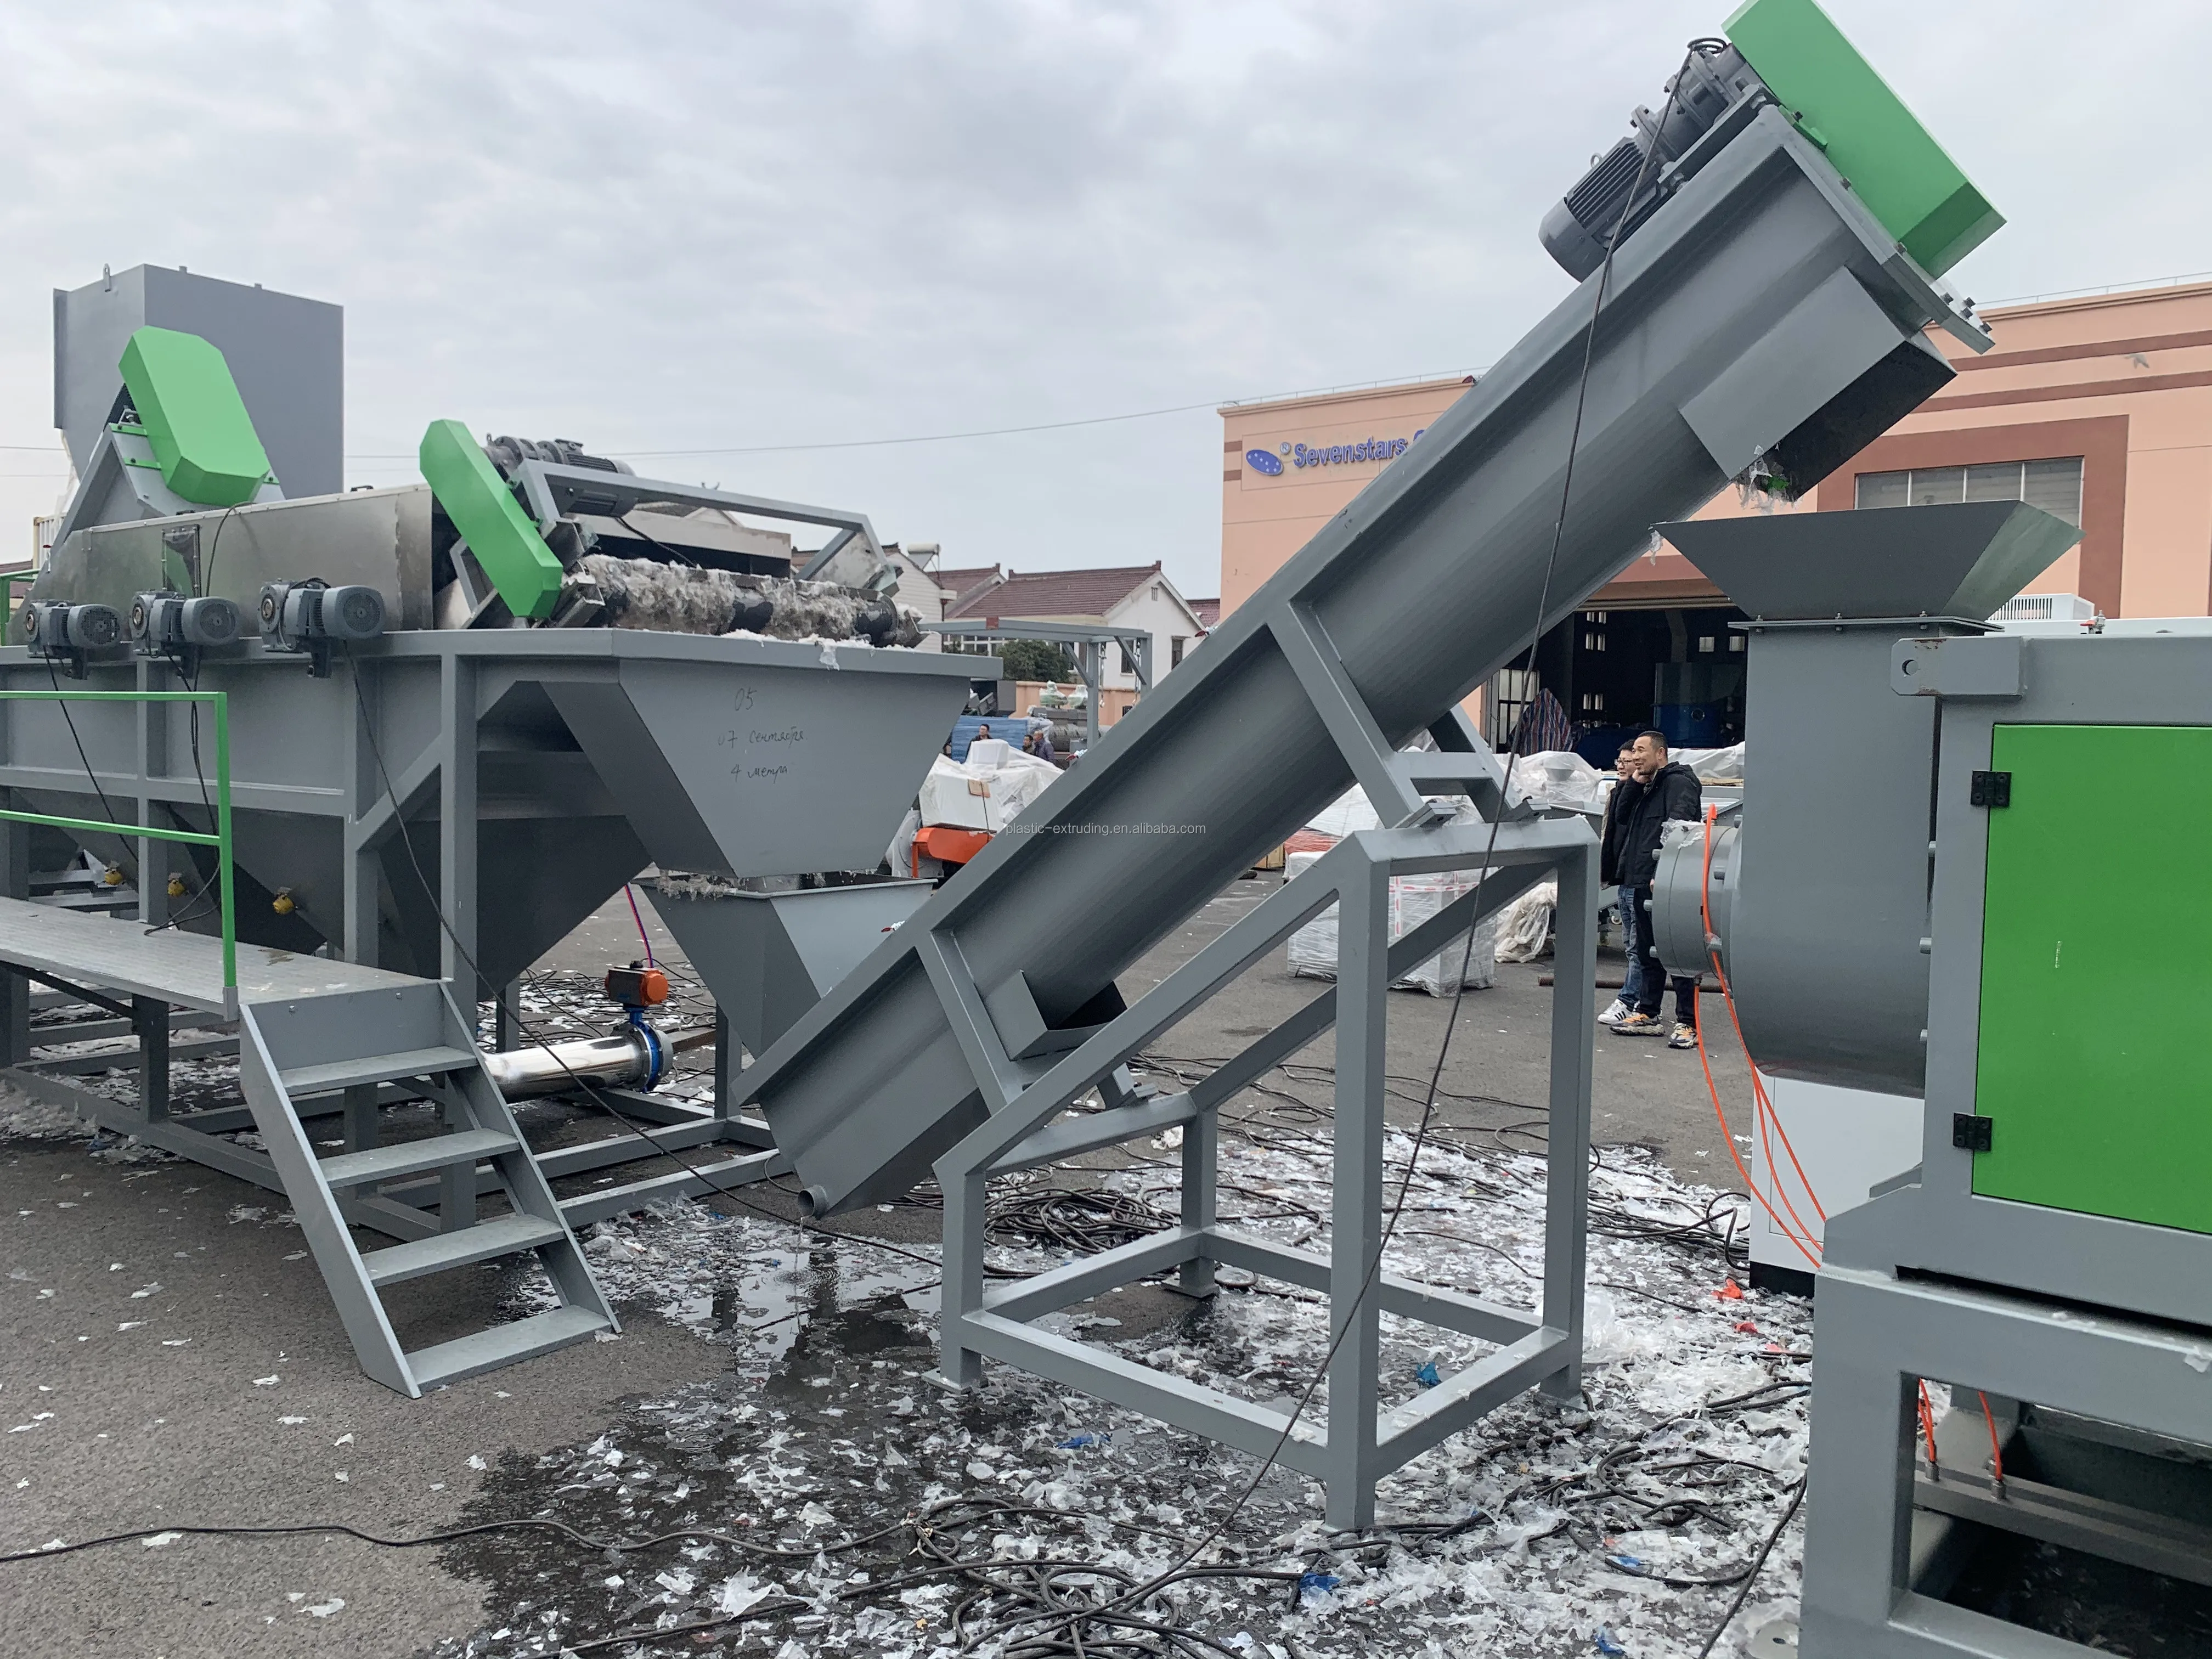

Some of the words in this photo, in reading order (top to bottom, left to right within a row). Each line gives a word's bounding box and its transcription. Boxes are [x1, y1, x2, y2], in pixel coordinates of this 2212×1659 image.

[1293, 435, 1408, 469] Sevenstars
[735, 687, 757, 711] 05
[731, 764, 742, 783] 4
